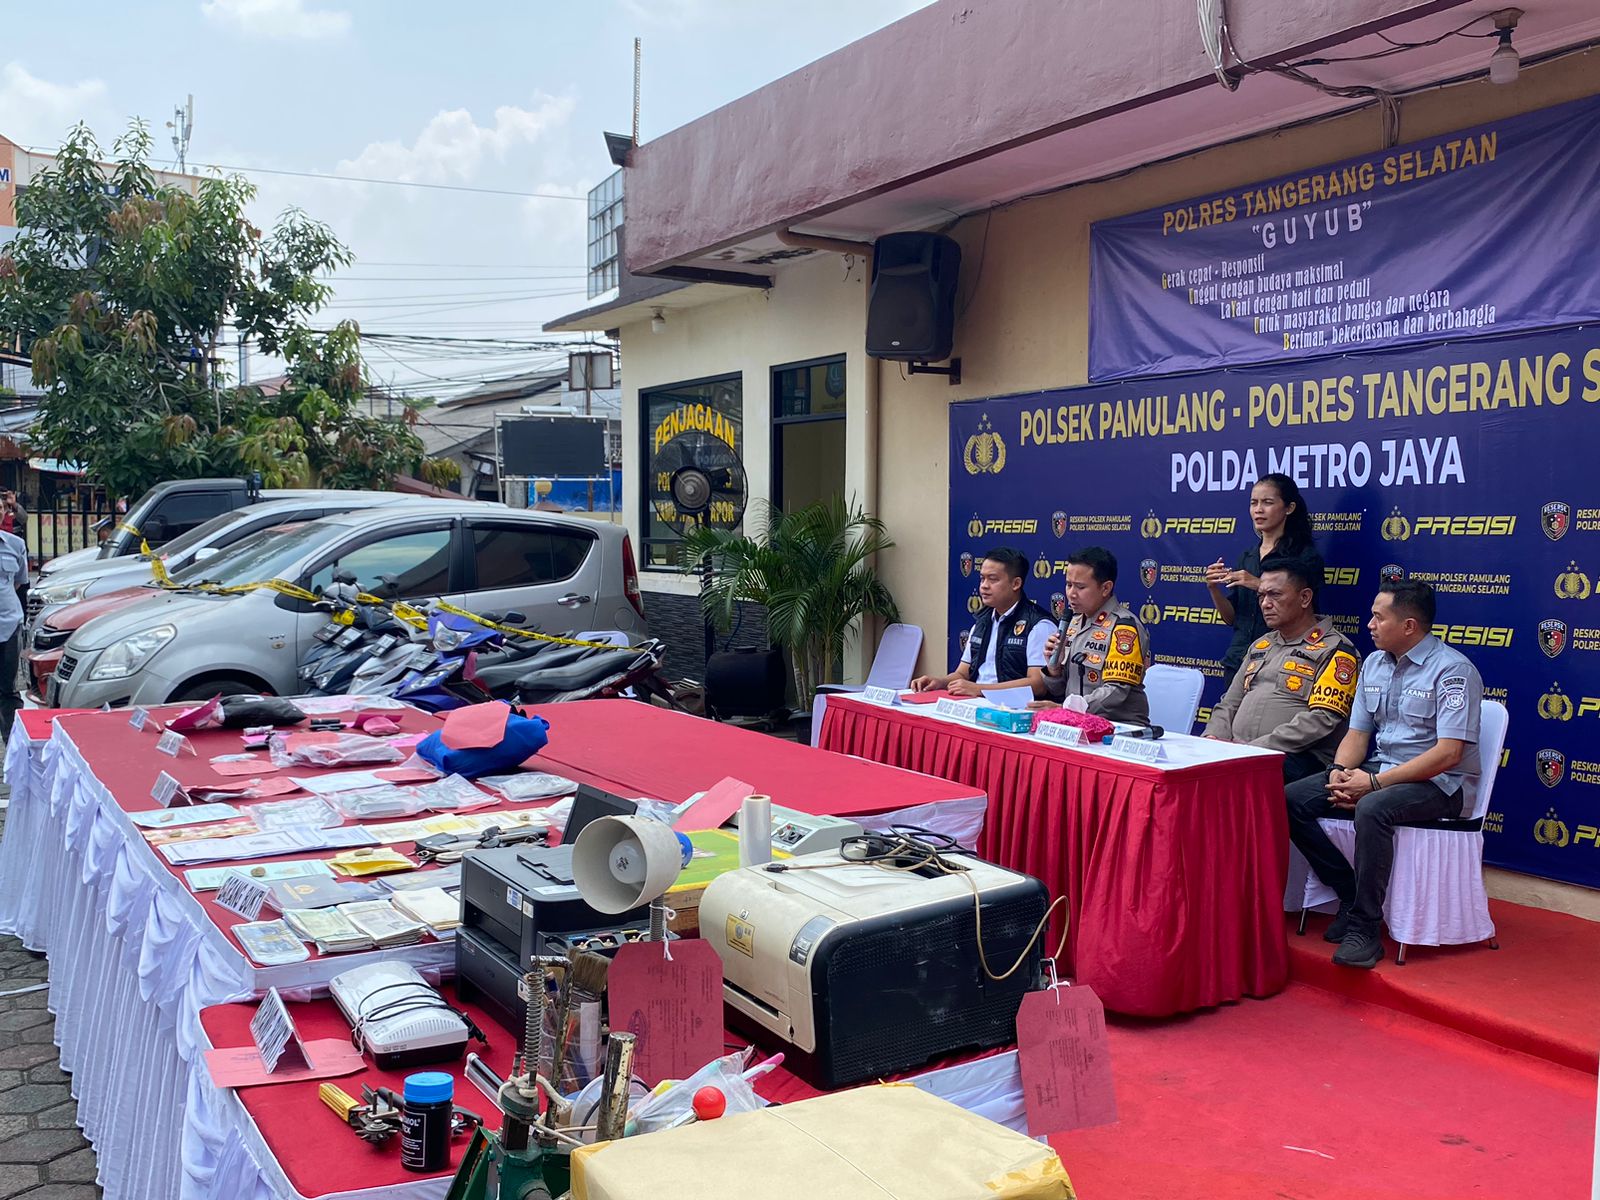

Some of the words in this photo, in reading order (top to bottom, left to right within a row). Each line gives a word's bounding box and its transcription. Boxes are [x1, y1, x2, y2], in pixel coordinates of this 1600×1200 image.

[1163, 197, 1237, 236] POLRES
[1242, 163, 1375, 217] TANGERANG
[1383, 132, 1497, 185] SELATAN
[1162, 269, 1185, 289] Gerak
[1189, 264, 1211, 285] cepat
[1189, 284, 1218, 305] Unggul
[1221, 279, 1254, 299] dengan
[1258, 272, 1291, 293] budaya
[1295, 261, 1343, 287] maksimal
[1254, 294, 1288, 314] dengan
[1292, 288, 1311, 308] hati
[1315, 286, 1333, 305] dan
[1338, 278, 1370, 303] peduli
[1254, 314, 1280, 334] Untuk
[1283, 304, 1342, 330] masyarakat
[1345, 299, 1382, 321] bangsa
[1386, 296, 1405, 315] dan
[1409, 289, 1450, 312] negara
[1332, 319, 1399, 344] bekerjasama
[1403, 316, 1423, 335] dan
[1428, 304, 1496, 332] berbahagia
[1020, 404, 1094, 446] POLSEK
[1099, 389, 1225, 441] PAMULANG
[1249, 376, 1355, 428] POLRES
[1362, 352, 1571, 419] TANGERANG
[655, 403, 735, 455] PENJAGAAN
[1171, 448, 1259, 492] POLDA
[1268, 441, 1371, 488] METRO
[1379, 436, 1466, 487] JAYA
[1327, 512, 1362, 521] PAMULANG
[985, 520, 1038, 533] PRESISI
[1164, 517, 1236, 534] PRESISI
[1334, 522, 1361, 531] SELATAN
[1414, 516, 1516, 535] PRESISI
[1183, 566, 1202, 574] POLSEK
[1440, 573, 1468, 583] POLSEK
[1469, 574, 1511, 584] PAMULANG
[1436, 583, 1476, 594] TANGERANG
[1477, 585, 1510, 595] SELATAN
[1431, 624, 1514, 647] RESISI
[1085, 641, 1107, 652] POLRI
[1120, 661, 1135, 673] OPS
[1176, 656, 1196, 665] POLSEK
[1323, 686, 1344, 699] OPS
[1407, 689, 1432, 699] KANIT
